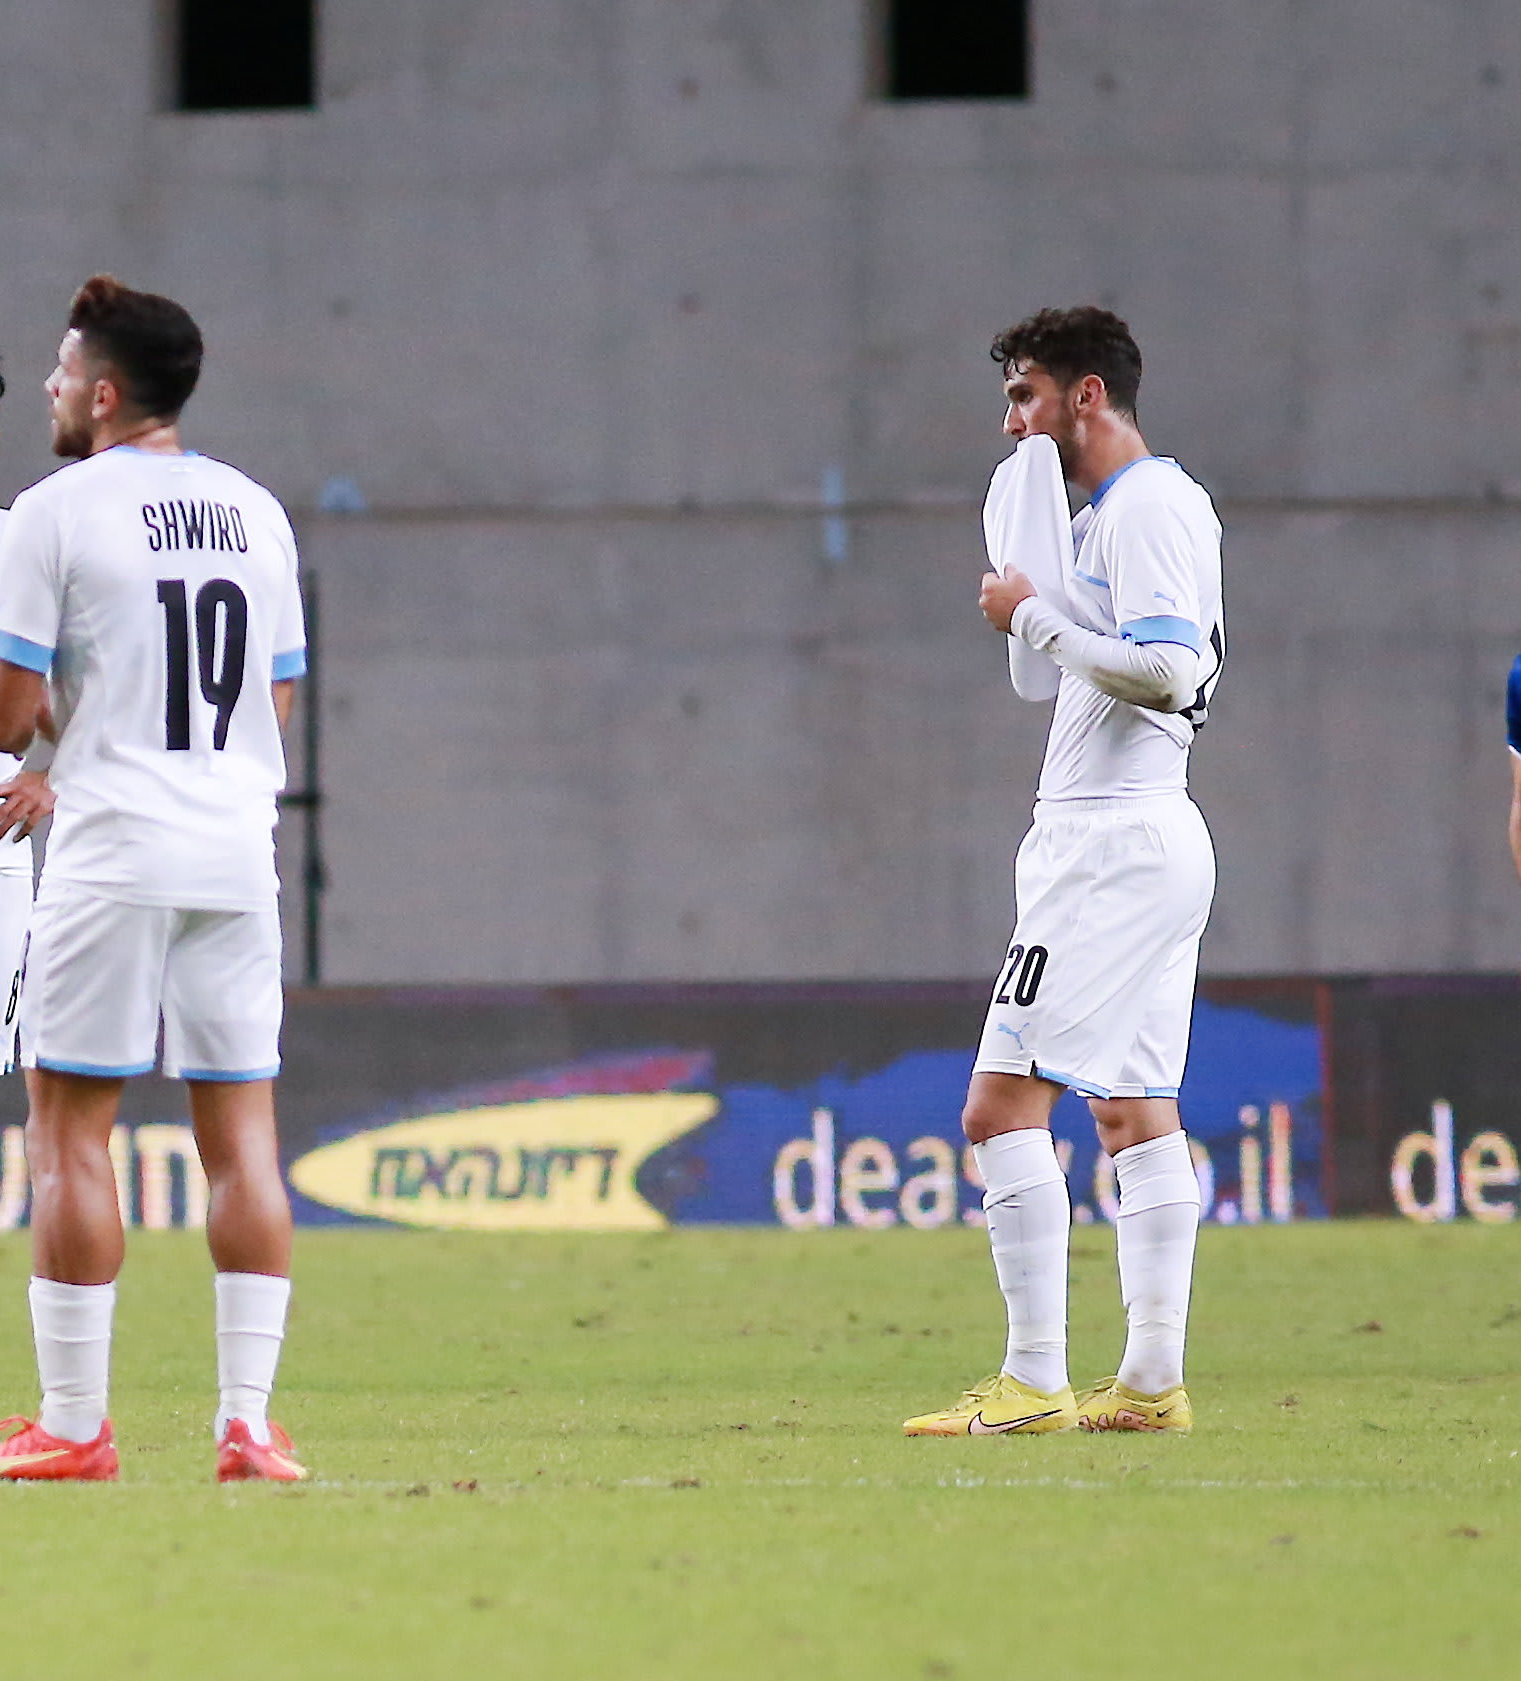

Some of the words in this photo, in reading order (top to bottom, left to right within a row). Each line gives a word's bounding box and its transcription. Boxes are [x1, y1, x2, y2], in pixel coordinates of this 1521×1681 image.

[142, 499, 247, 553] SHWIRO
[157, 579, 248, 751] 19
[994, 944, 1049, 1007] 20
[774, 1104, 1294, 1230] dea..il
